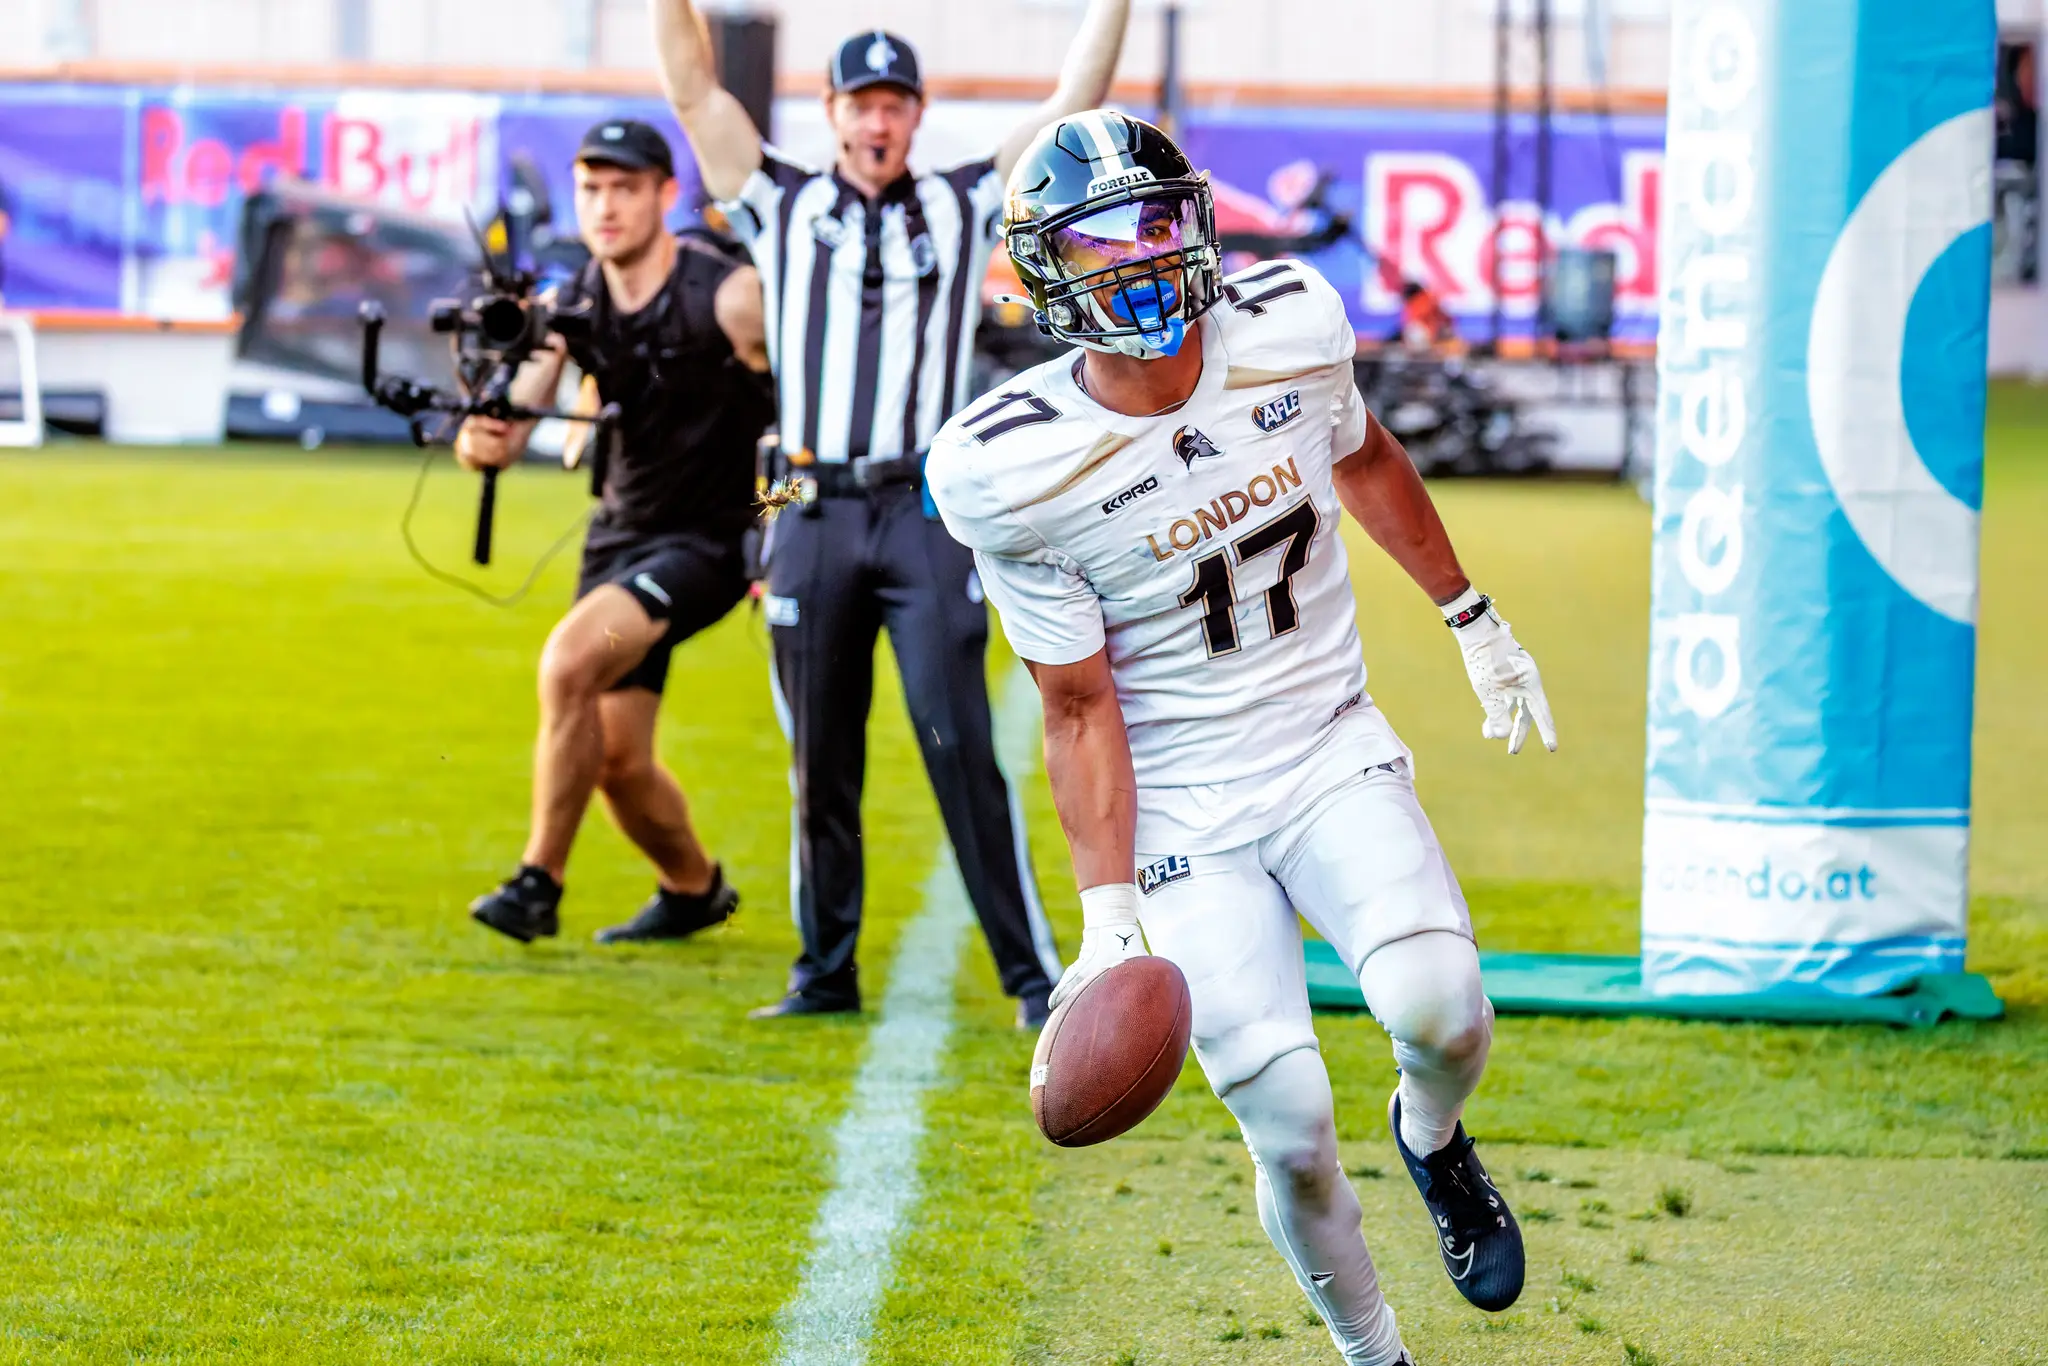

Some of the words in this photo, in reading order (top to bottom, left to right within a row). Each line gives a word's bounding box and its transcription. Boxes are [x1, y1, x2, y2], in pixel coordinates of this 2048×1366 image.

[143, 106, 307, 207] Red
[323, 112, 480, 213] Bull
[1091, 172, 1149, 194] FORELLE
[1366, 158, 1662, 312] Red
[958, 388, 1063, 446] 17
[1263, 390, 1300, 428] AFLE
[1146, 455, 1302, 562] LONDON
[1177, 493, 1321, 660] 17
[1144, 856, 1189, 890] AFLE
